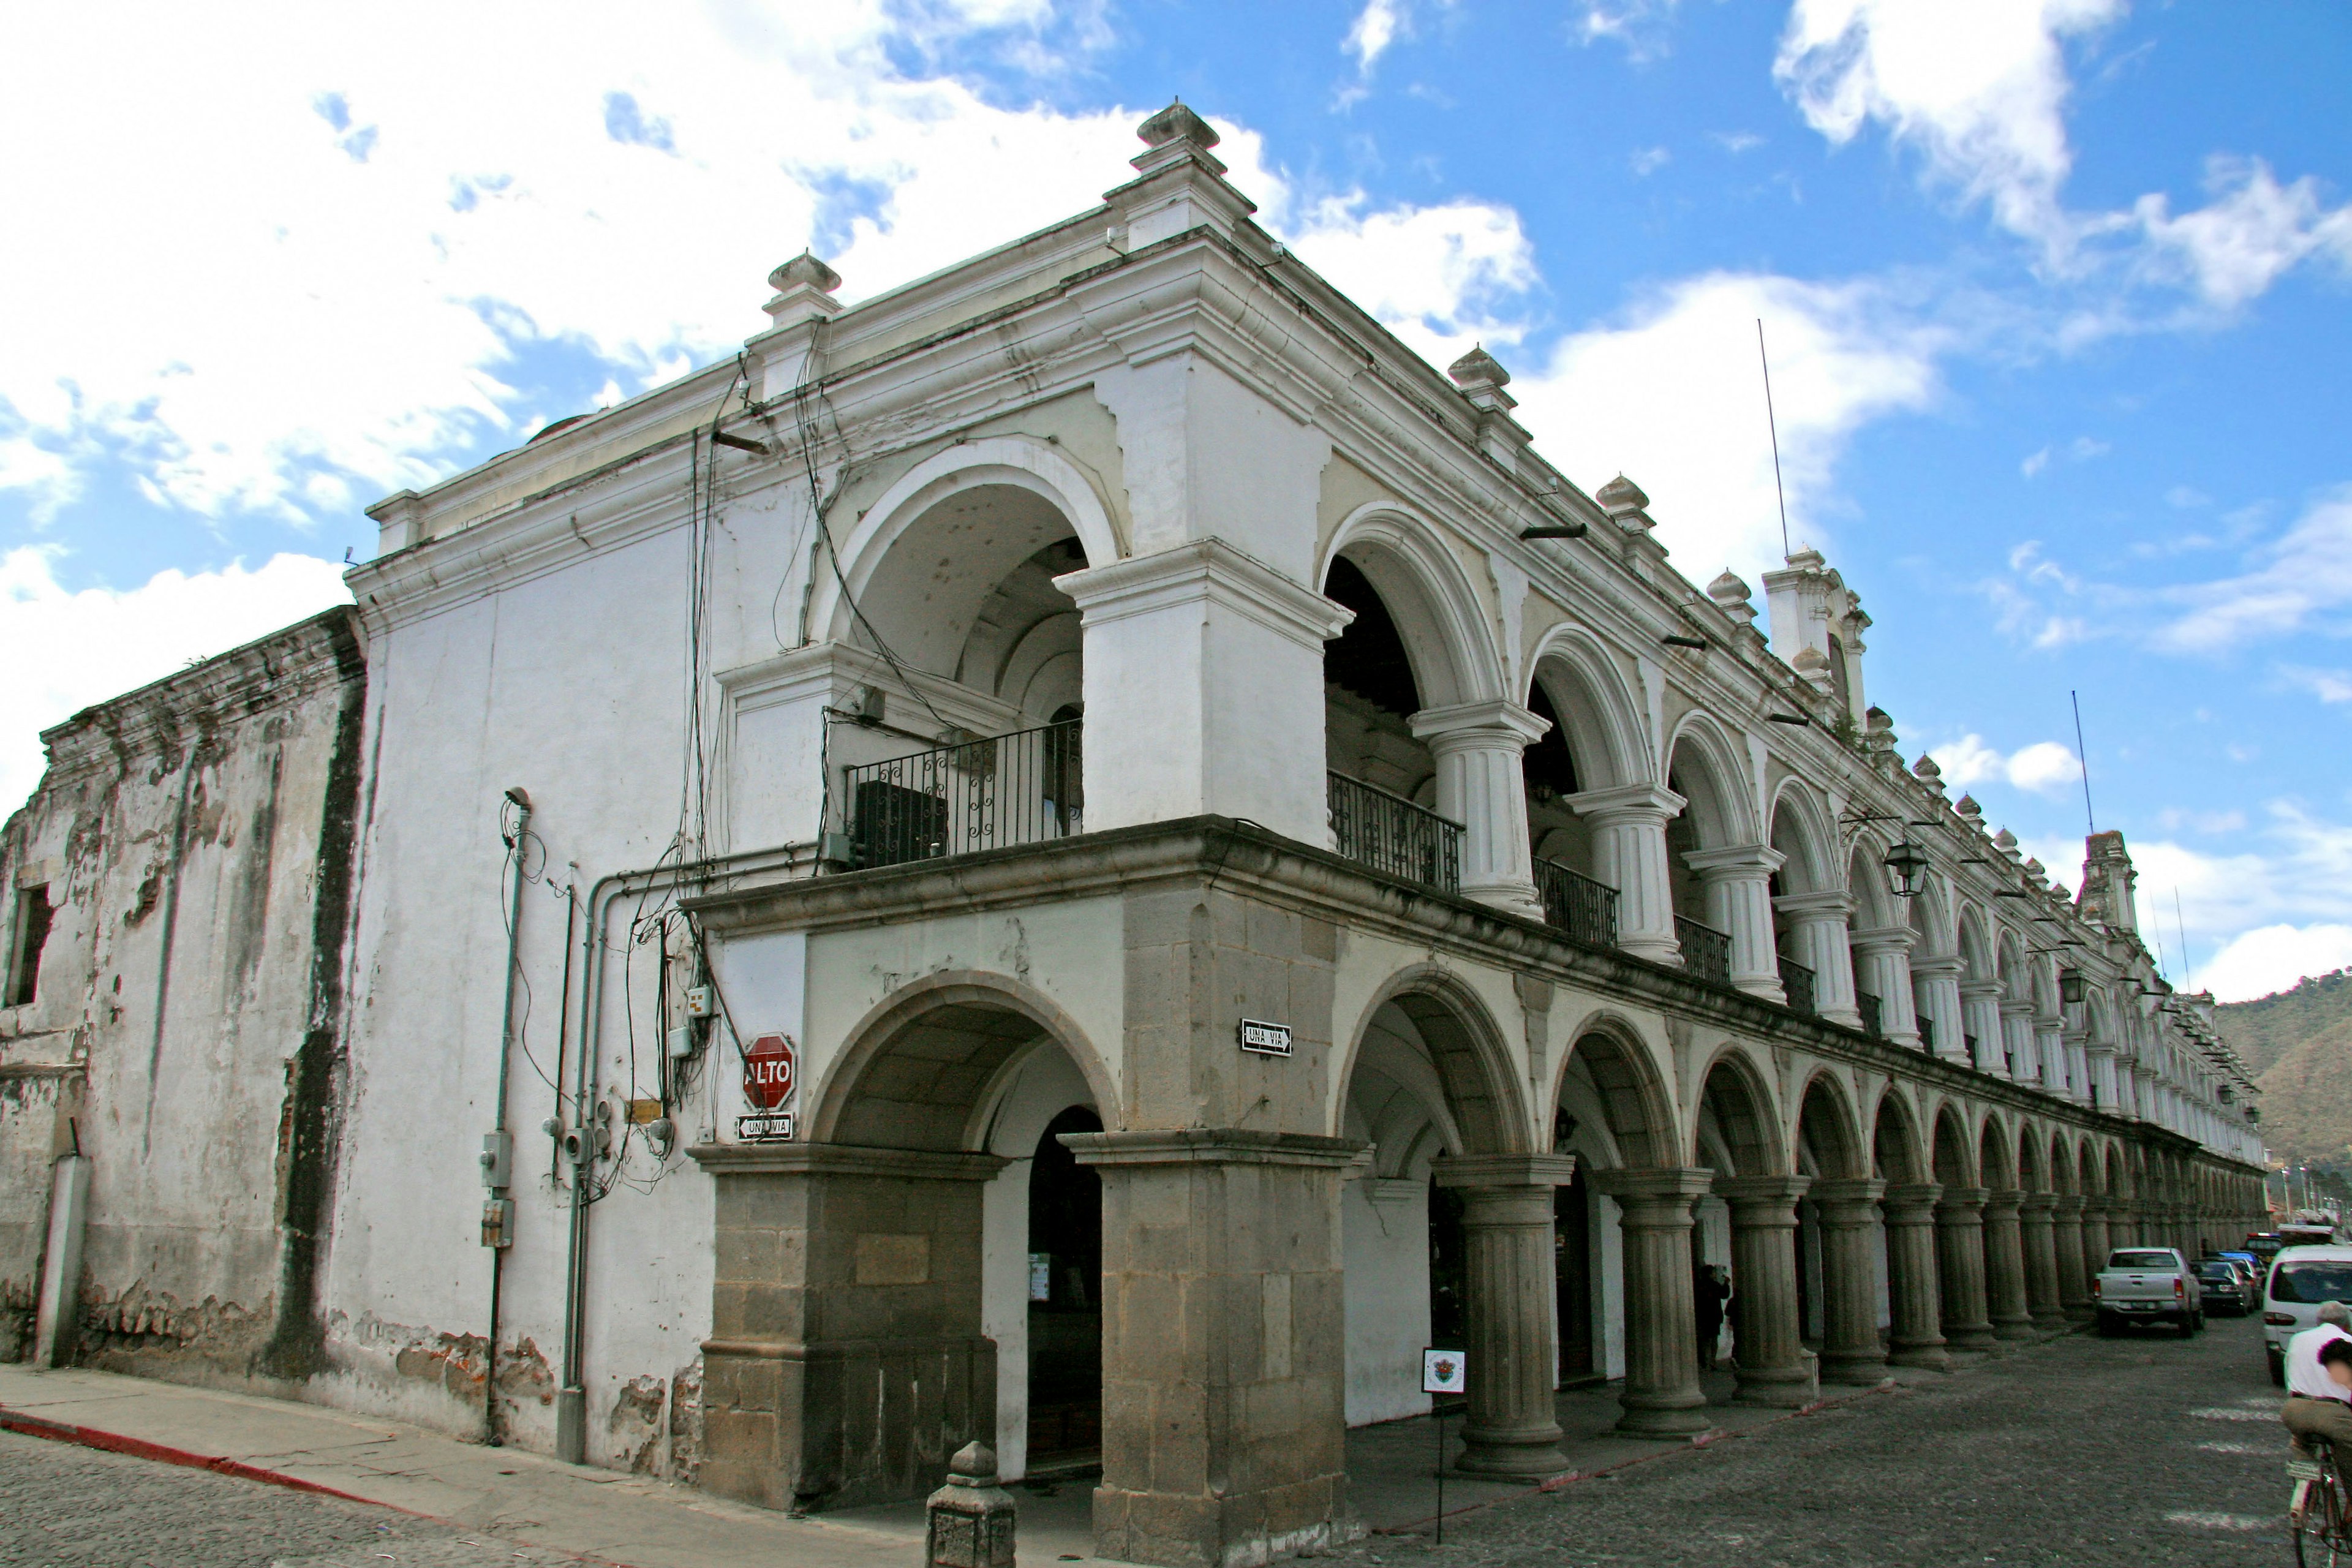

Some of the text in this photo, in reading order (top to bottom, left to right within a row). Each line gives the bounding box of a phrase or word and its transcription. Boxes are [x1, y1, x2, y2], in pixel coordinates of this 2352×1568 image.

[1250, 1028, 1282, 1046] UNA VIA
[745, 1060, 790, 1085] ALTO
[772, 1120, 786, 1132] VIA
